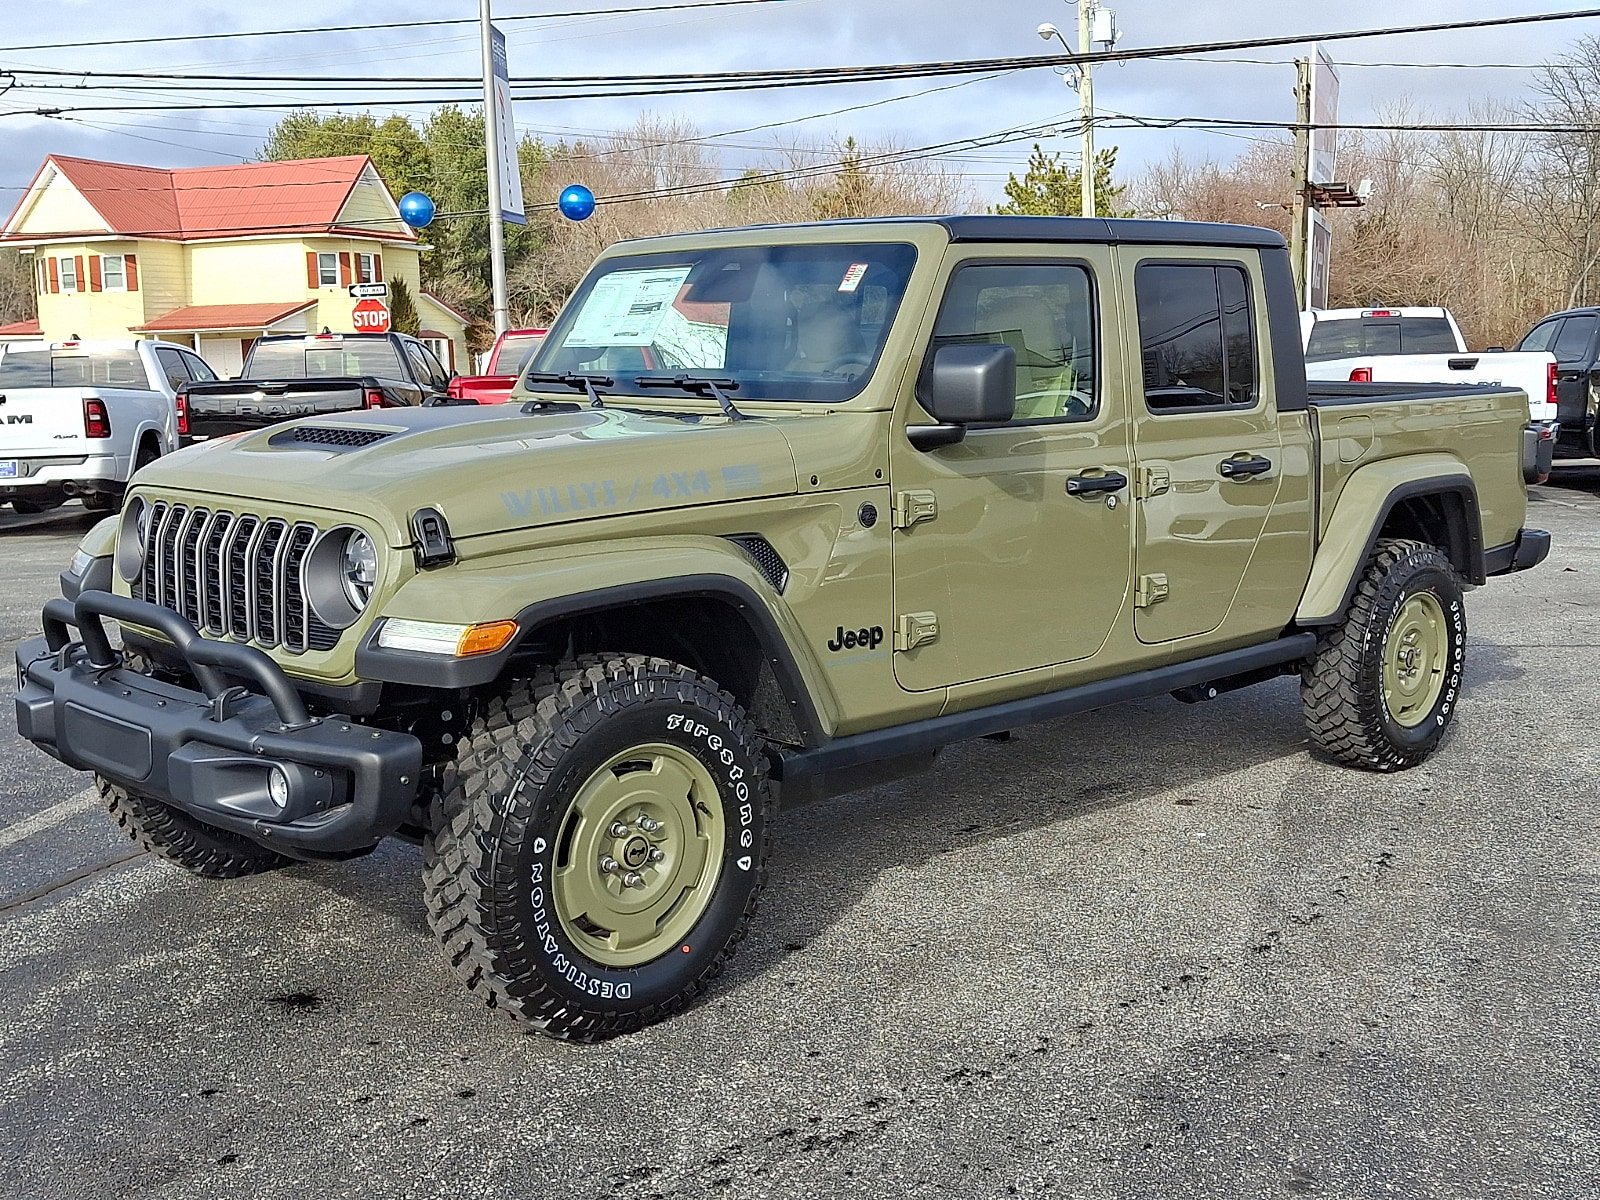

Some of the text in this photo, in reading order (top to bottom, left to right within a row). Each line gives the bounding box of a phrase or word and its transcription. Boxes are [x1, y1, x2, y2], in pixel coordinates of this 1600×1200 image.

[353, 310, 388, 327] STOP
[236, 404, 316, 416] RAM
[828, 625, 884, 652] Jeep
[666, 713, 753, 849] Firestone
[530, 862, 632, 999] DESTINATION
